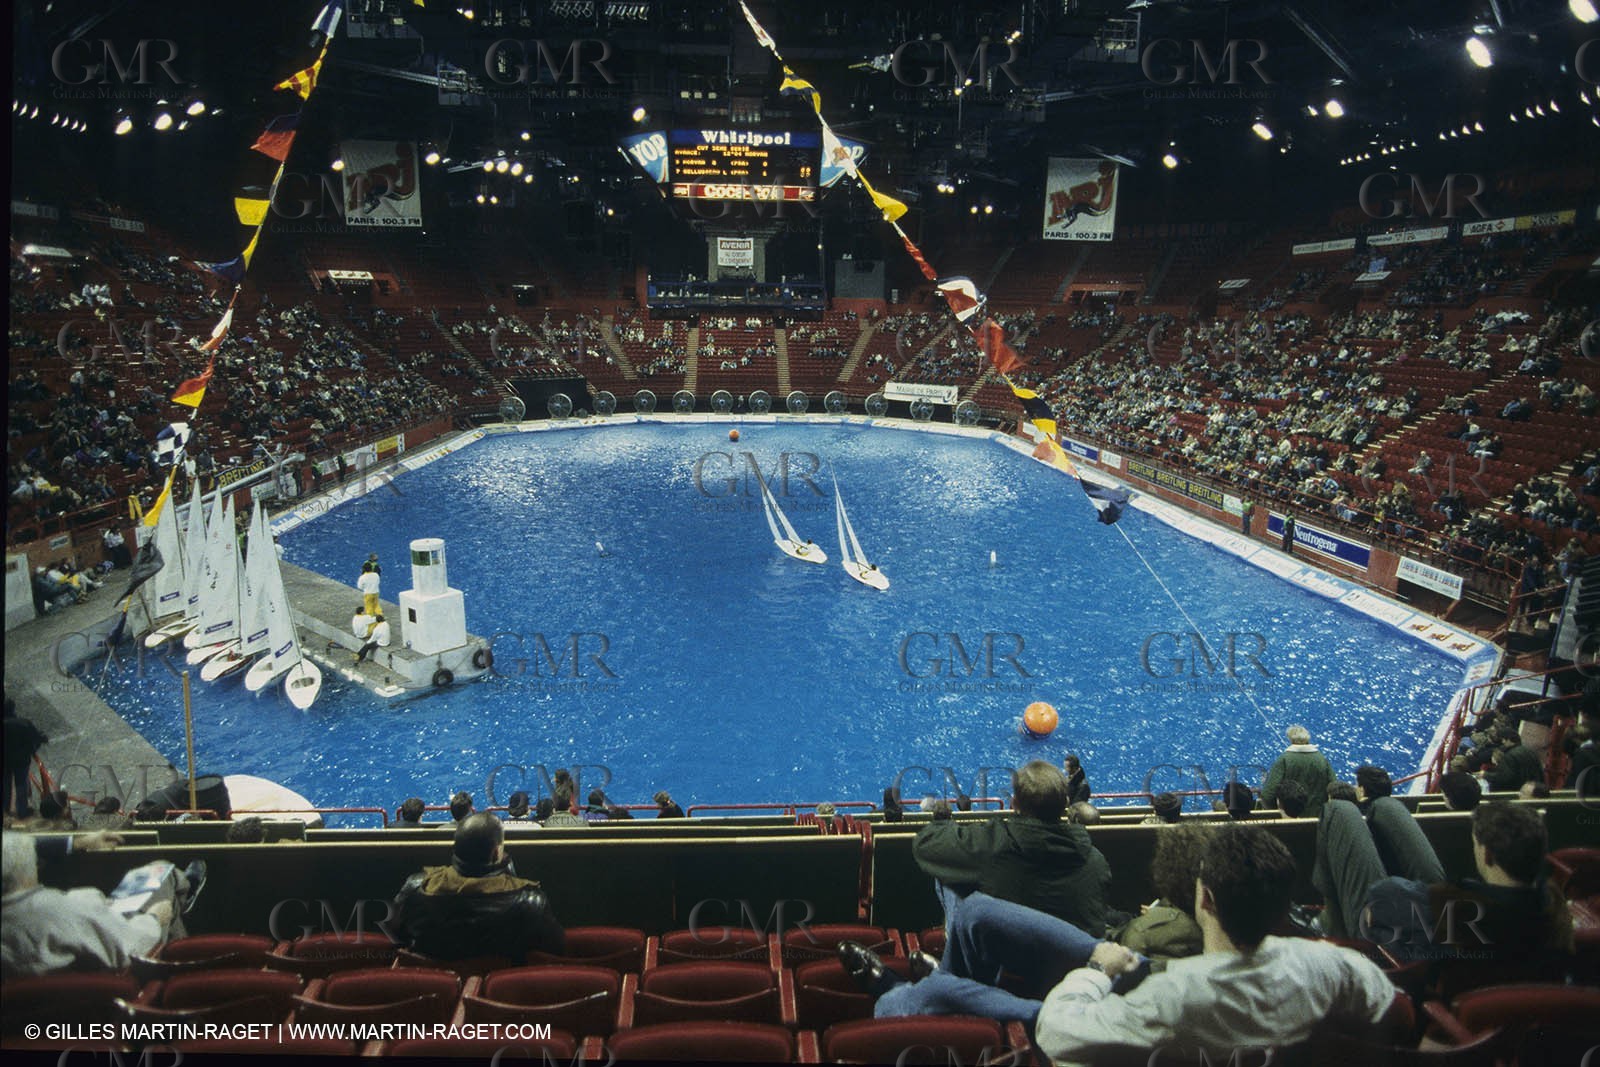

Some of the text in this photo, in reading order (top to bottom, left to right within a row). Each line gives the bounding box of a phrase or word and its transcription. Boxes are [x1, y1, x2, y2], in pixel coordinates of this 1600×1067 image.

[701, 130, 791, 146] Whirlpool
[628, 134, 667, 167] YOP
[347, 216, 379, 225] PARIS:
[381, 217, 407, 225] 100.3
[1045, 231, 1073, 239] PARIS:
[720, 241, 751, 250] AVENIR
[1156, 471, 1187, 490] BREITLING
[1188, 483, 1223, 504] BREITLING
[1292, 525, 1338, 553] Neutrogena
